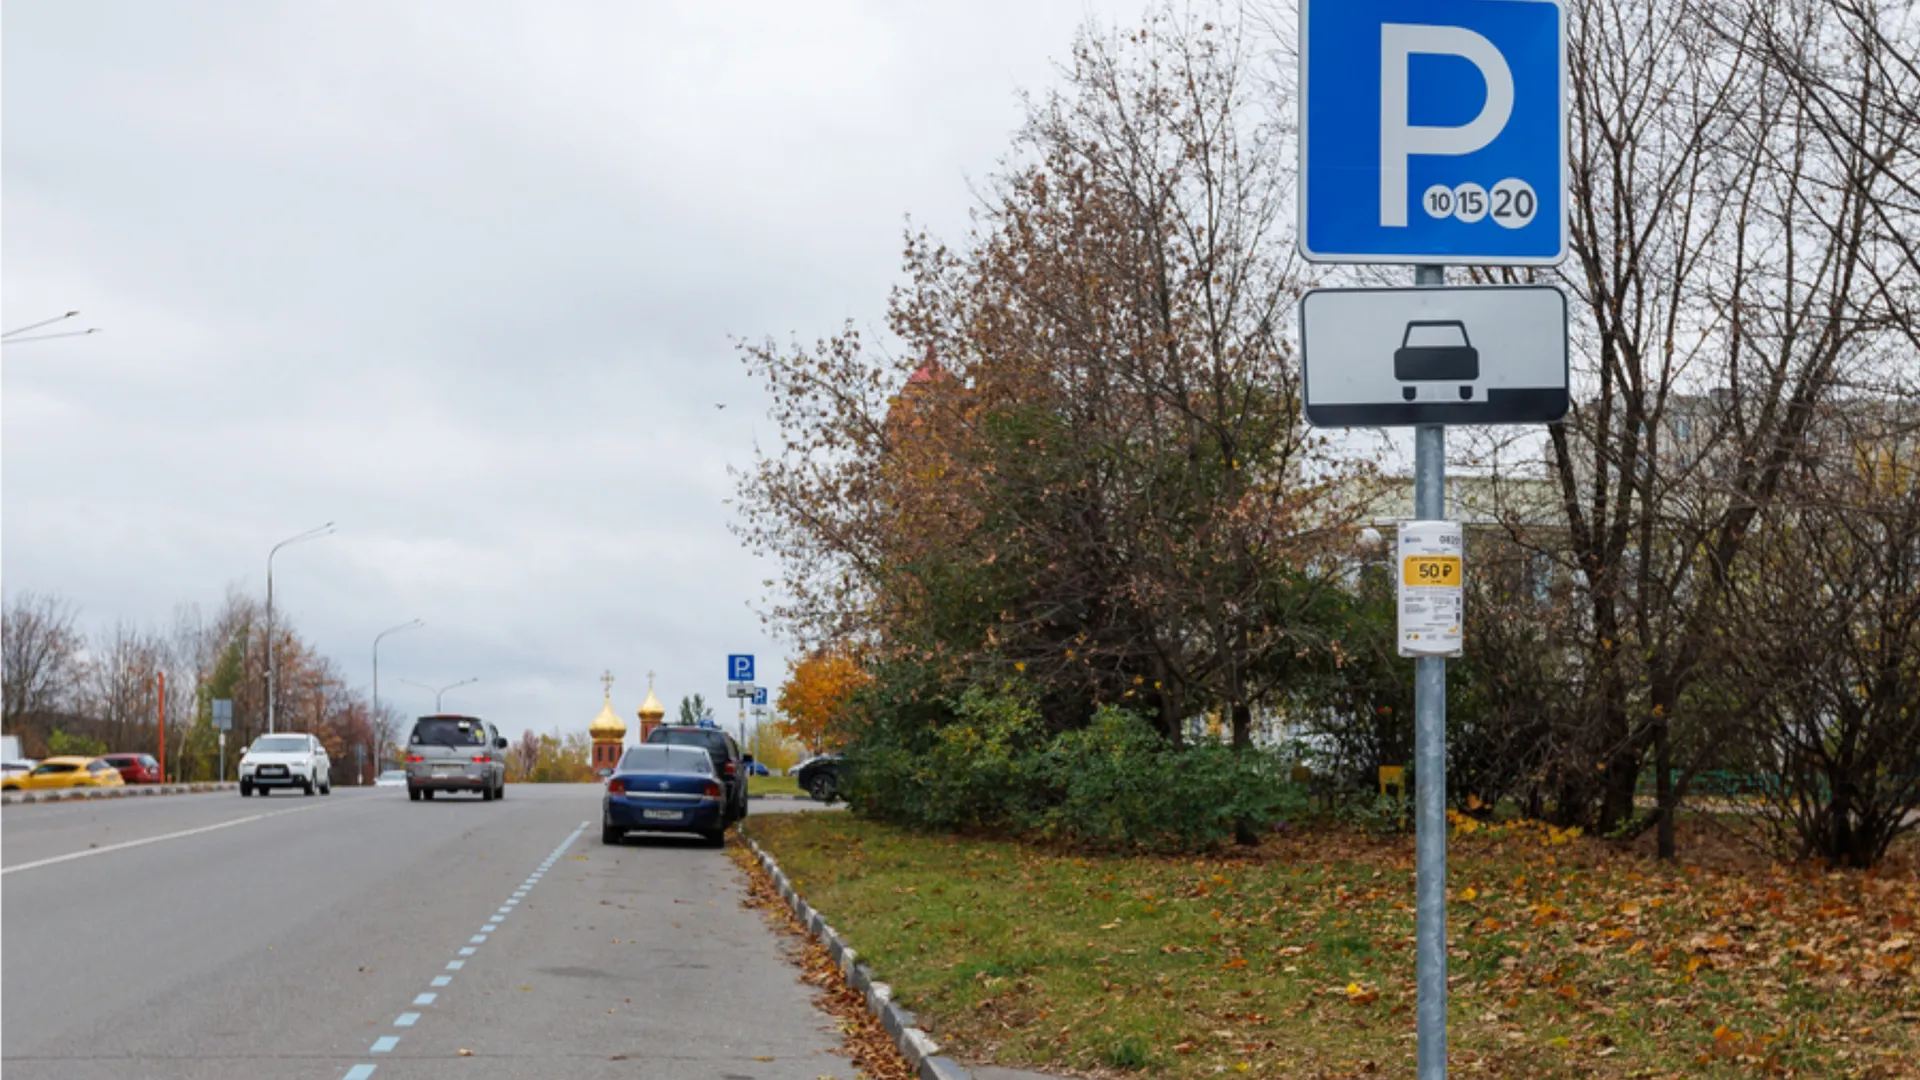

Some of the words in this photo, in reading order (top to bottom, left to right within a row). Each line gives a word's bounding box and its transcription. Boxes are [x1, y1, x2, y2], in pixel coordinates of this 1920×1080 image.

[1379, 23, 1515, 228] P
[1429, 192, 1450, 212] 10
[1459, 191, 1483, 215] 15
[1493, 188, 1534, 218] 20
[1419, 563, 1439, 578] 50
[735, 656, 750, 678] P
